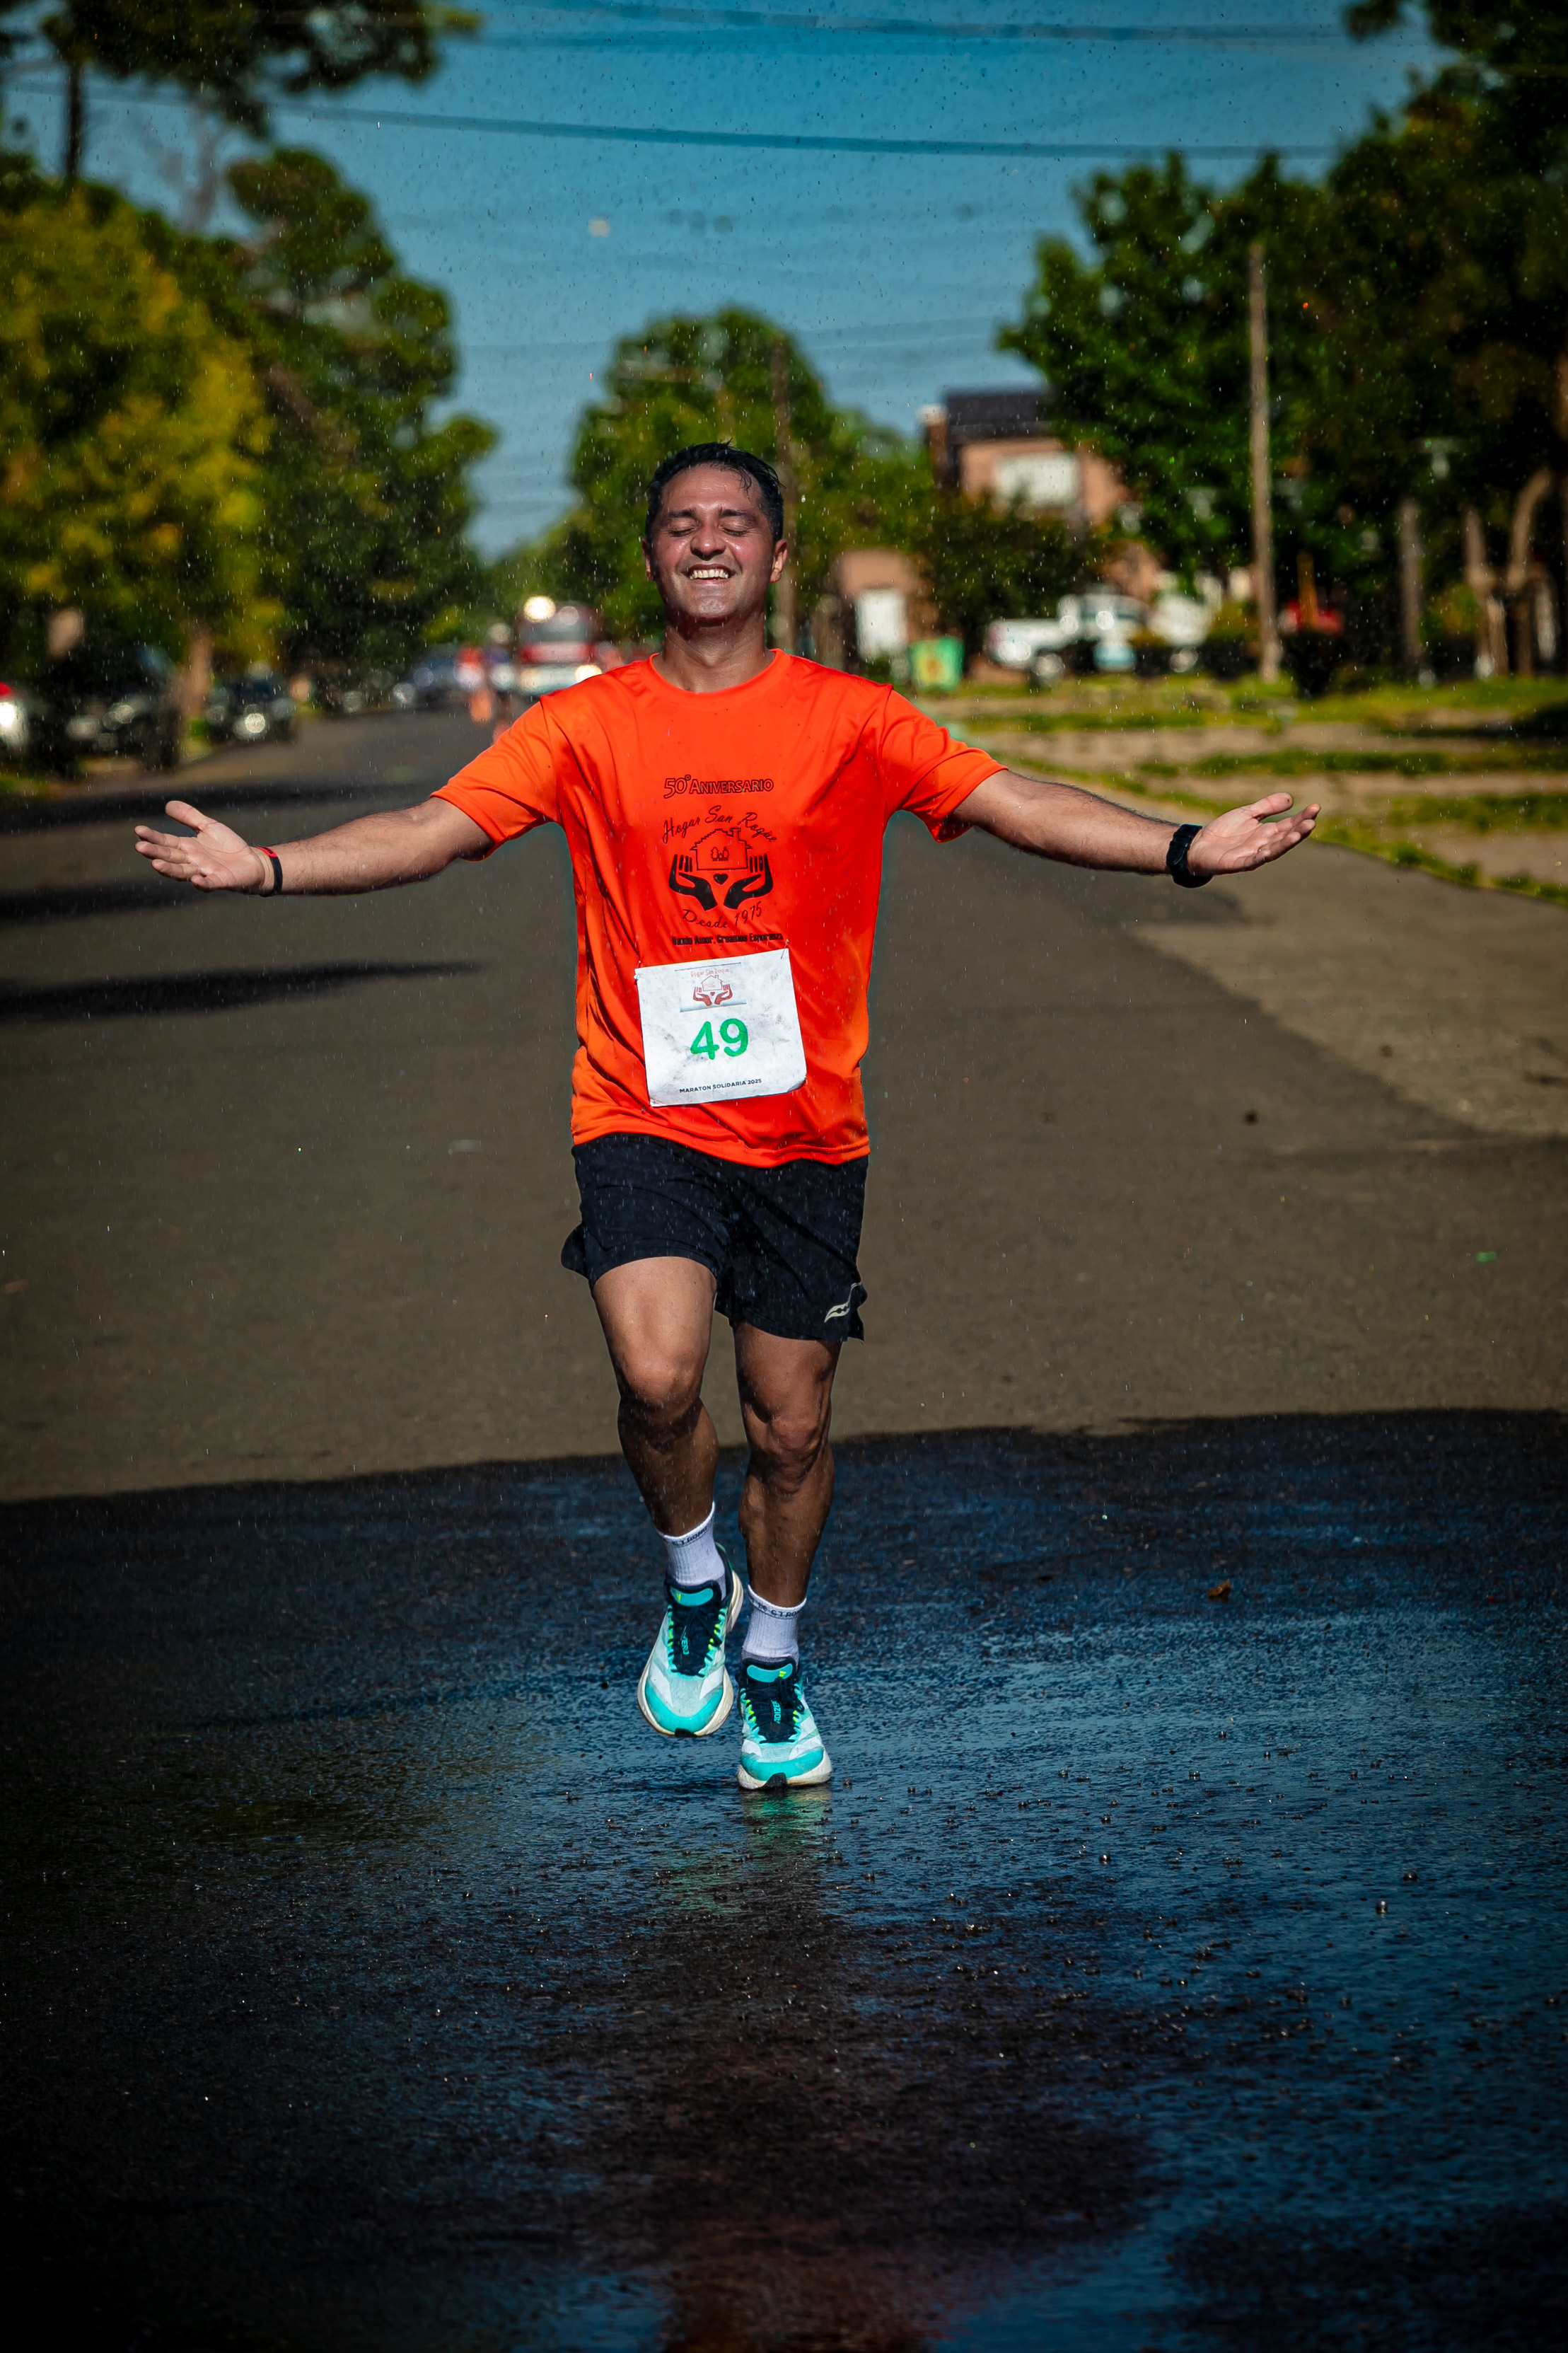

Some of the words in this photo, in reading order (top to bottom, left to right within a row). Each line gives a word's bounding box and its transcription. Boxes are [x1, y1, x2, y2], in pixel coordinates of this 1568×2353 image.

[663, 817, 700, 844] Hogar
[704, 805, 733, 823] San
[738, 812, 777, 842] Roque
[683, 908, 728, 928] Desde
[734, 901, 762, 927] 1975
[716, 934, 748, 944] Creamos
[690, 1017, 749, 1060] 49
[712, 1080, 746, 1089] SOLIDARIA
